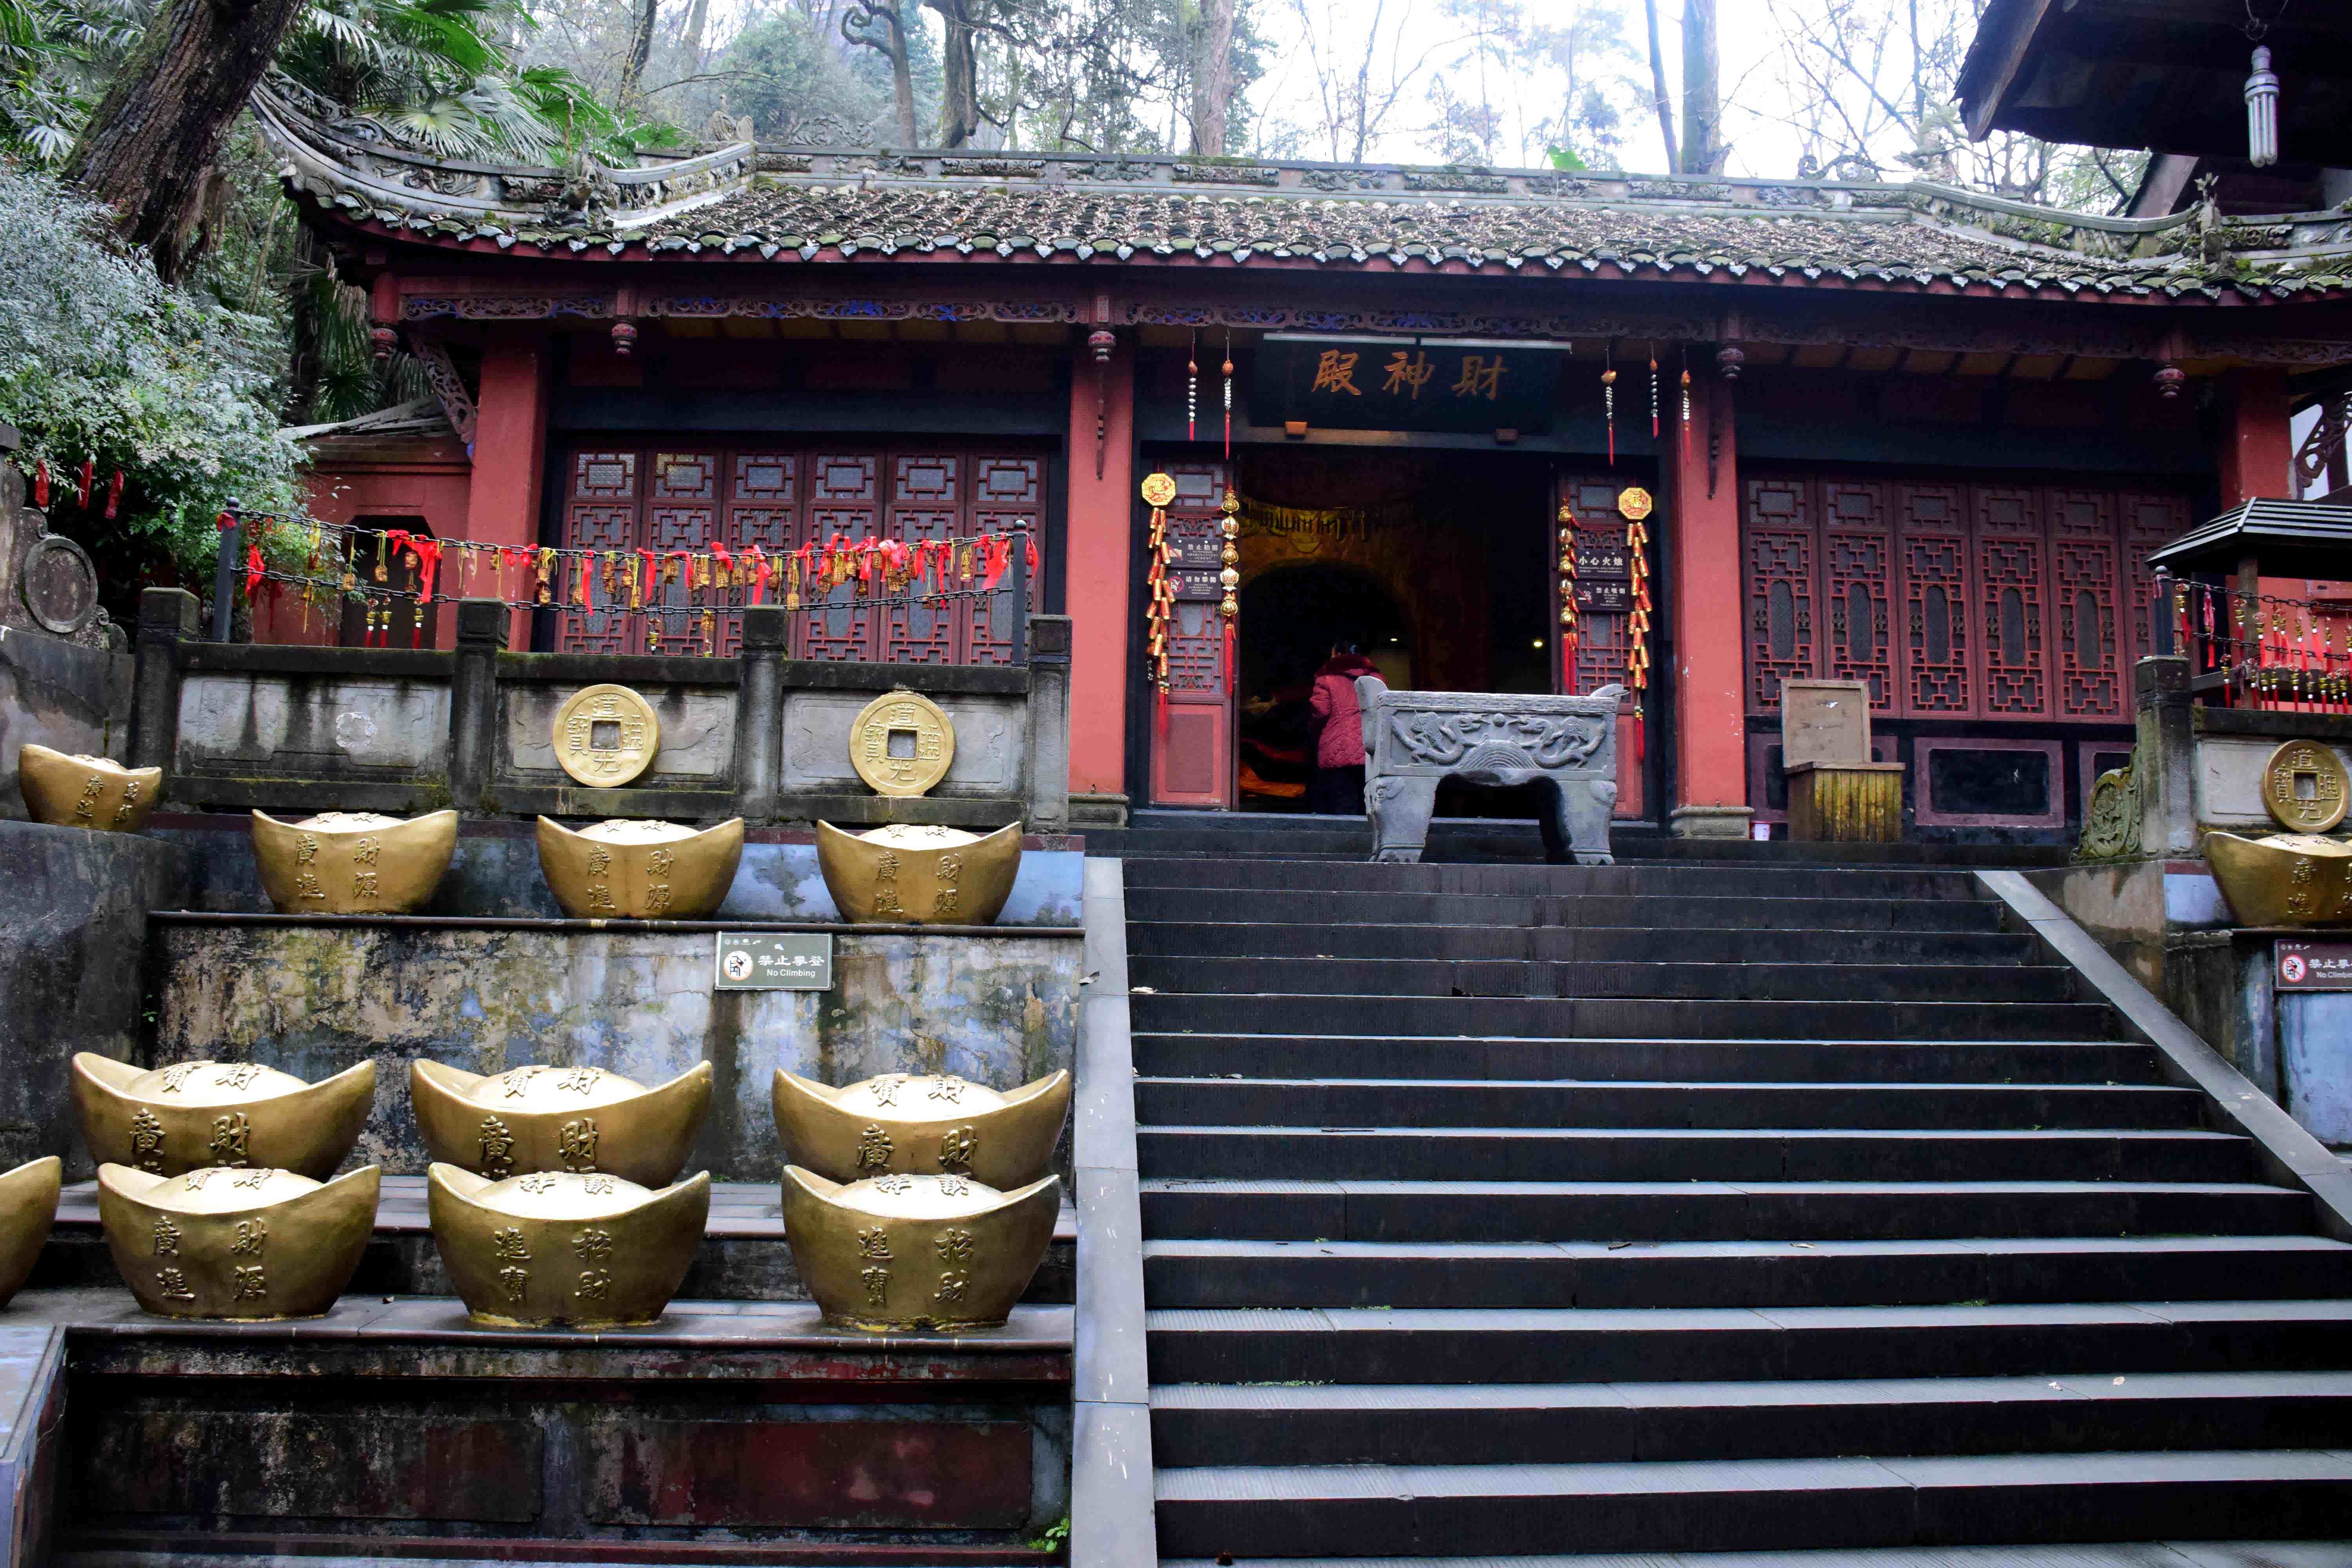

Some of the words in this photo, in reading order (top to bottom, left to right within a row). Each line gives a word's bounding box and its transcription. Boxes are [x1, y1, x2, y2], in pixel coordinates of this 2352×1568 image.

[1579, 556, 1623, 566] 小心火烛
[757, 955, 824, 966] 禁止攀登
[2308, 958, 2352, 968] 禁止攀
[780, 969, 816, 978] Climbing
